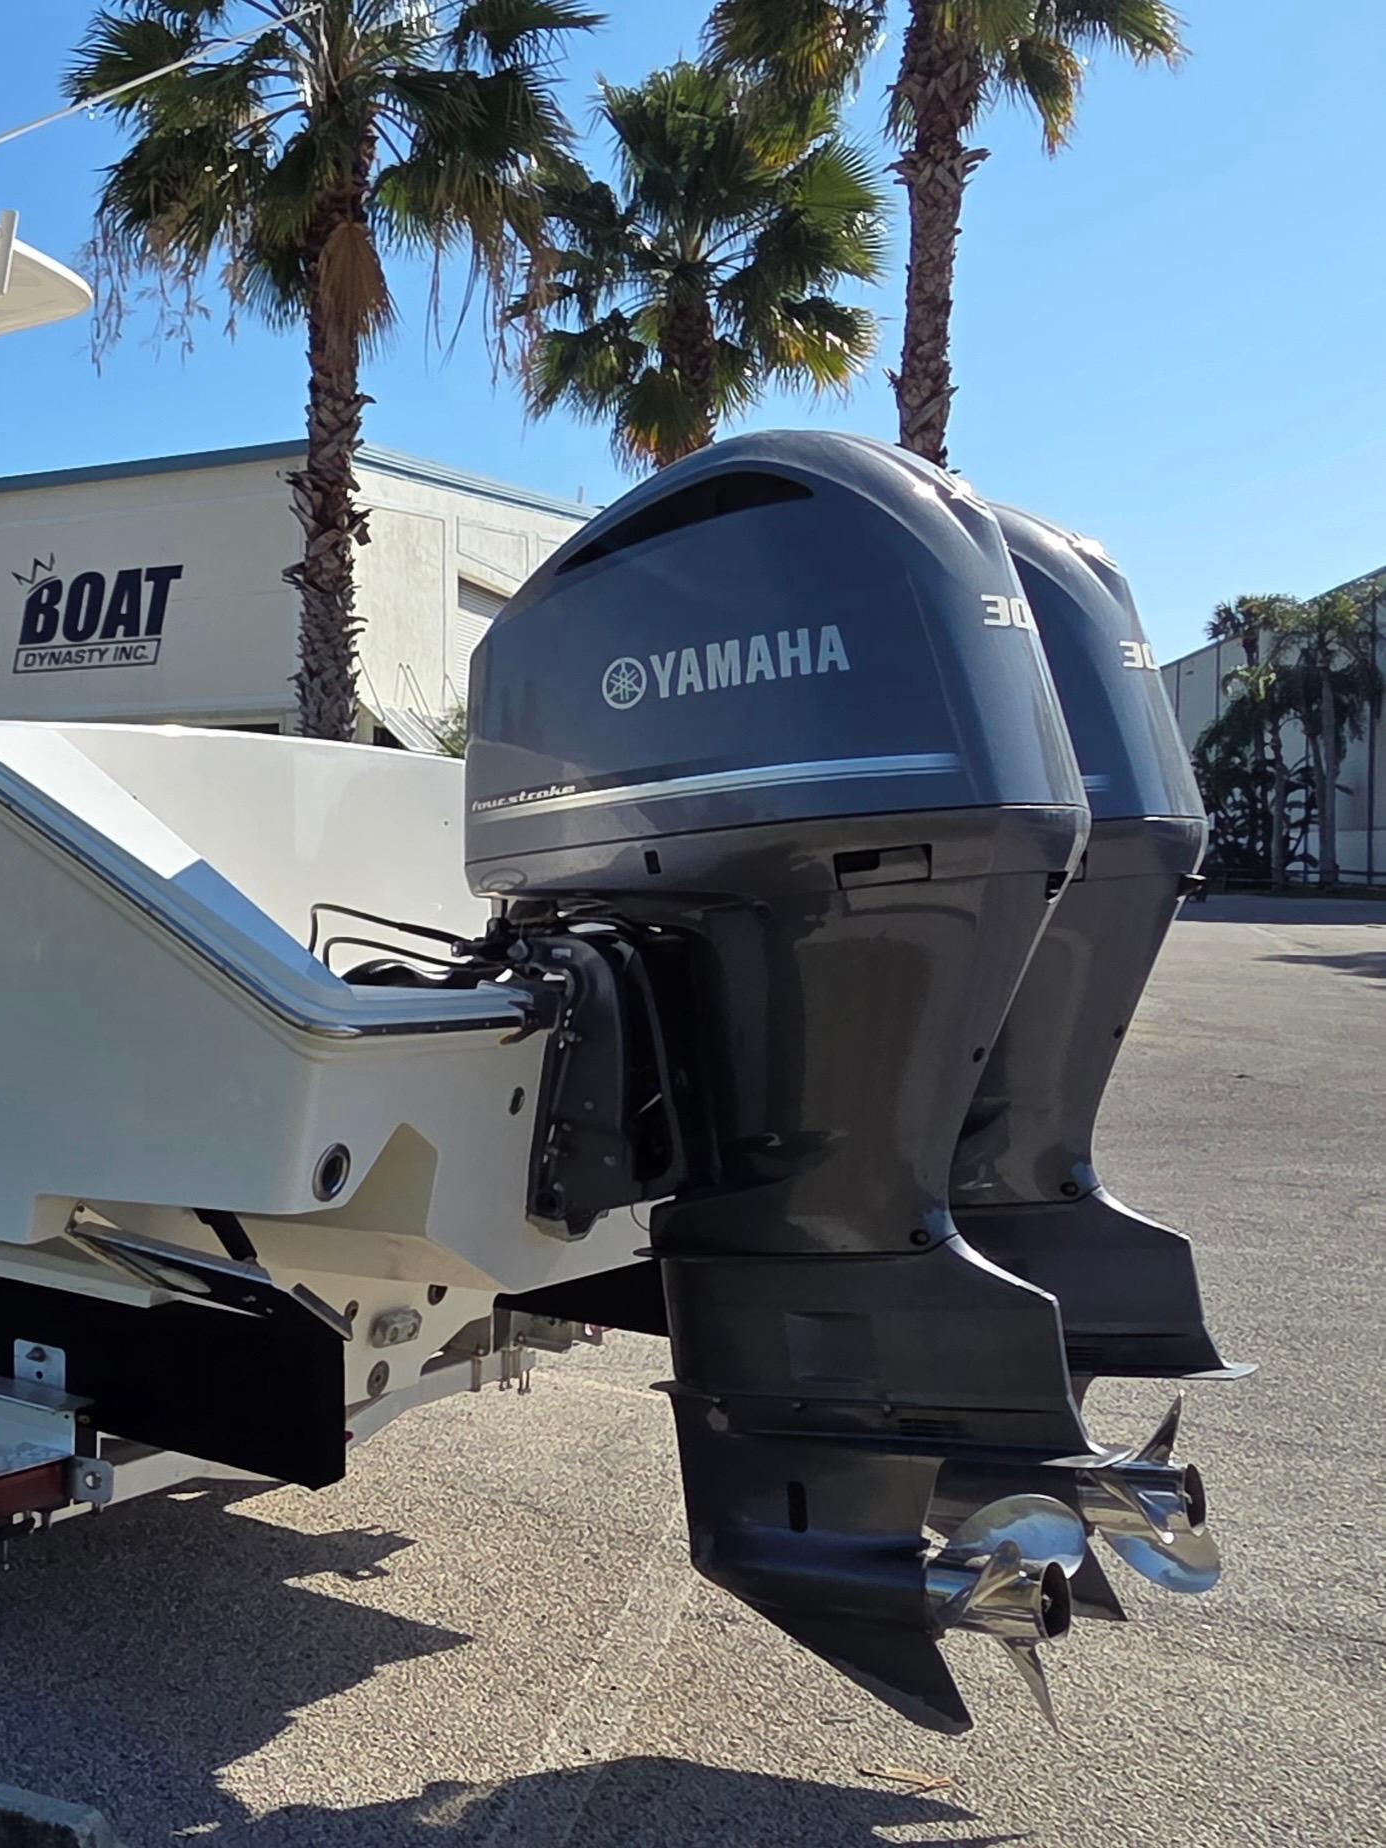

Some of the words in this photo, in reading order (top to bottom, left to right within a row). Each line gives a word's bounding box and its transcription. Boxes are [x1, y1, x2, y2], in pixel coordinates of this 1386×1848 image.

[19, 565, 183, 645] BOAT
[23, 647, 109, 667] DYNASTY
[114, 645, 148, 661] INC.
[649, 625, 850, 699] YAMAHA
